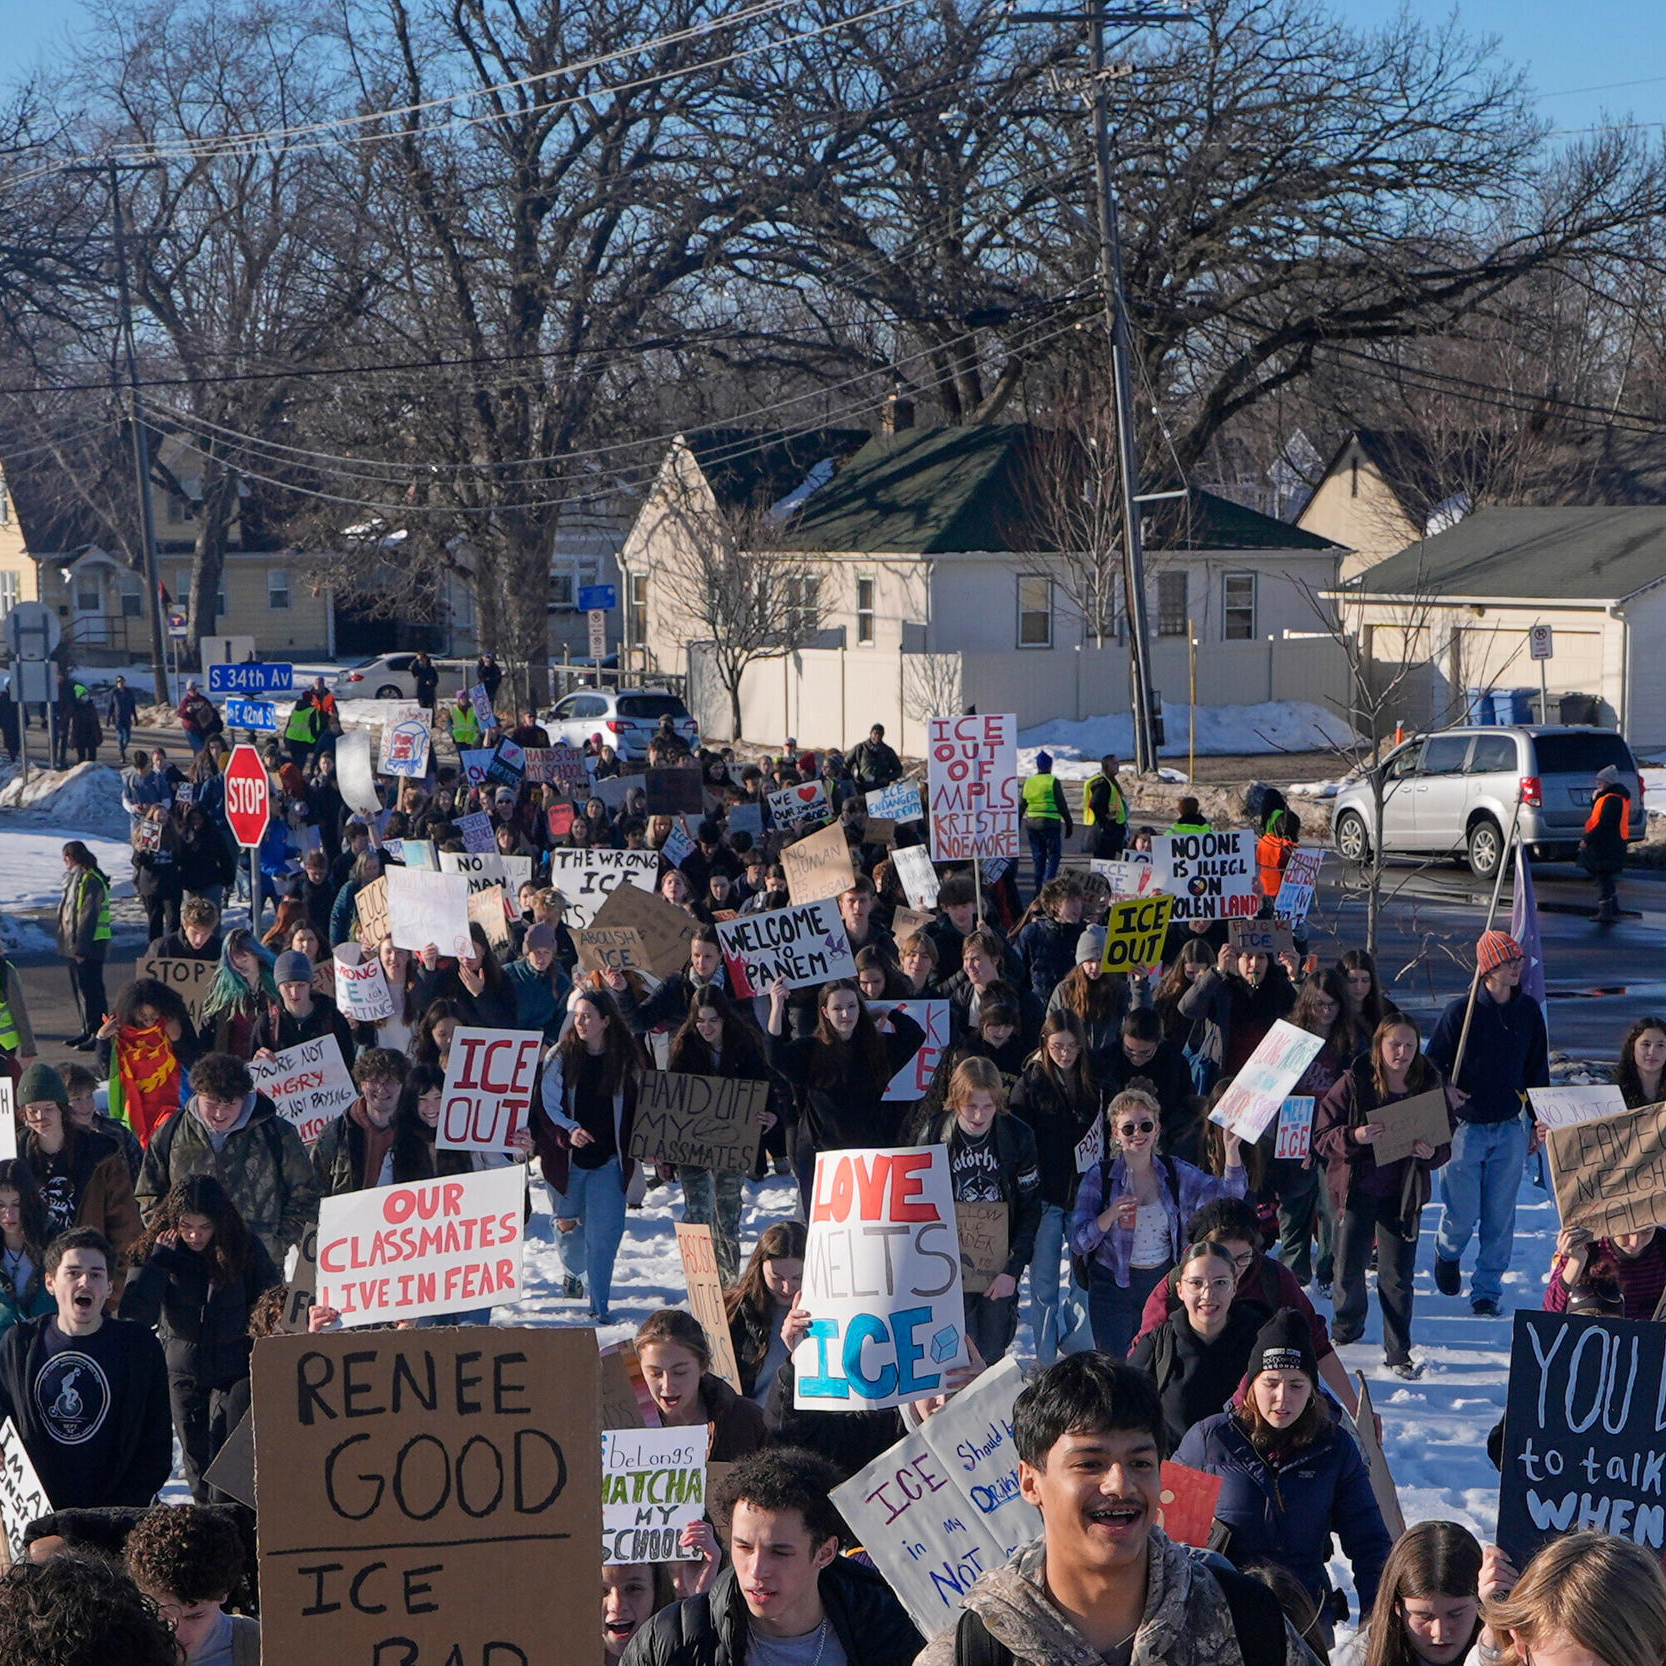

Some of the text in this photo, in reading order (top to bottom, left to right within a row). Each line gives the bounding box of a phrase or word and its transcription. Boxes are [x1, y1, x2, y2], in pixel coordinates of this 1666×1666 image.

[211, 668, 290, 688] S 34th Av
[235, 705, 264, 724] E 42nd
[932, 716, 1004, 742] ICE
[525, 749, 562, 761] HANDS
[934, 741, 1004, 762] OUT
[527, 764, 543, 779] MY
[947, 760, 995, 781] OF
[228, 777, 265, 814] STOP
[771, 792, 792, 807] WE
[880, 785, 905, 798] ICE
[932, 777, 1017, 811] MPLS
[774, 806, 795, 820] OUR
[933, 810, 1017, 835] KRISTI
[557, 850, 658, 869] THE WRONG
[786, 844, 807, 861] NO
[1171, 837, 1199, 860] NO
[1202, 833, 1241, 858] ONE
[457, 857, 483, 872] NO
[789, 844, 842, 881] HUMAN
[1174, 860, 1188, 878] IS
[1115, 900, 1170, 934] ICE
[1220, 895, 1258, 917] LAND
[580, 929, 636, 946] ABOLISH
[721, 905, 830, 953] WELCOME
[1233, 920, 1289, 932] FUCK
[1238, 933, 1274, 948] ICE
[598, 949, 635, 968] ICE
[775, 945, 794, 959] TO
[1107, 933, 1162, 965] OUT
[145, 960, 206, 983] STOP
[744, 951, 829, 990] PANEM
[301, 1040, 325, 1066] NOT
[454, 1038, 539, 1094] ICE
[289, 1097, 309, 1119] NOT
[311, 1087, 352, 1109] PAYING
[639, 1070, 712, 1115] HAND
[444, 1097, 530, 1147] OUT
[633, 1111, 694, 1142] MY
[1535, 1104, 1563, 1124] NO
[631, 1133, 753, 1171] CLASSMATES
[1278, 1126, 1309, 1157] ICE
[1551, 1114, 1654, 1173] LEAVE
[812, 1152, 942, 1223] LOVE
[382, 1183, 465, 1225] OUR
[319, 1212, 518, 1273] CLASSMATES
[805, 1223, 958, 1300] MELTS
[322, 1258, 516, 1314] LIVE IN FEAR
[798, 1306, 942, 1400] ICE
[298, 1350, 532, 1426] RENEE
[1526, 1322, 1639, 1435] YOU
[325, 1429, 566, 1521] GOOD
[865, 1422, 1004, 1526] ICE Should
[1518, 1438, 1564, 1483] to
[1580, 1447, 1666, 1497] talk
[634, 1505, 679, 1526] MY
[1527, 1489, 1665, 1549] WHEN
[901, 1540, 927, 1561] in
[298, 1562, 444, 1616] ICE
[929, 1547, 984, 1608] NOT
